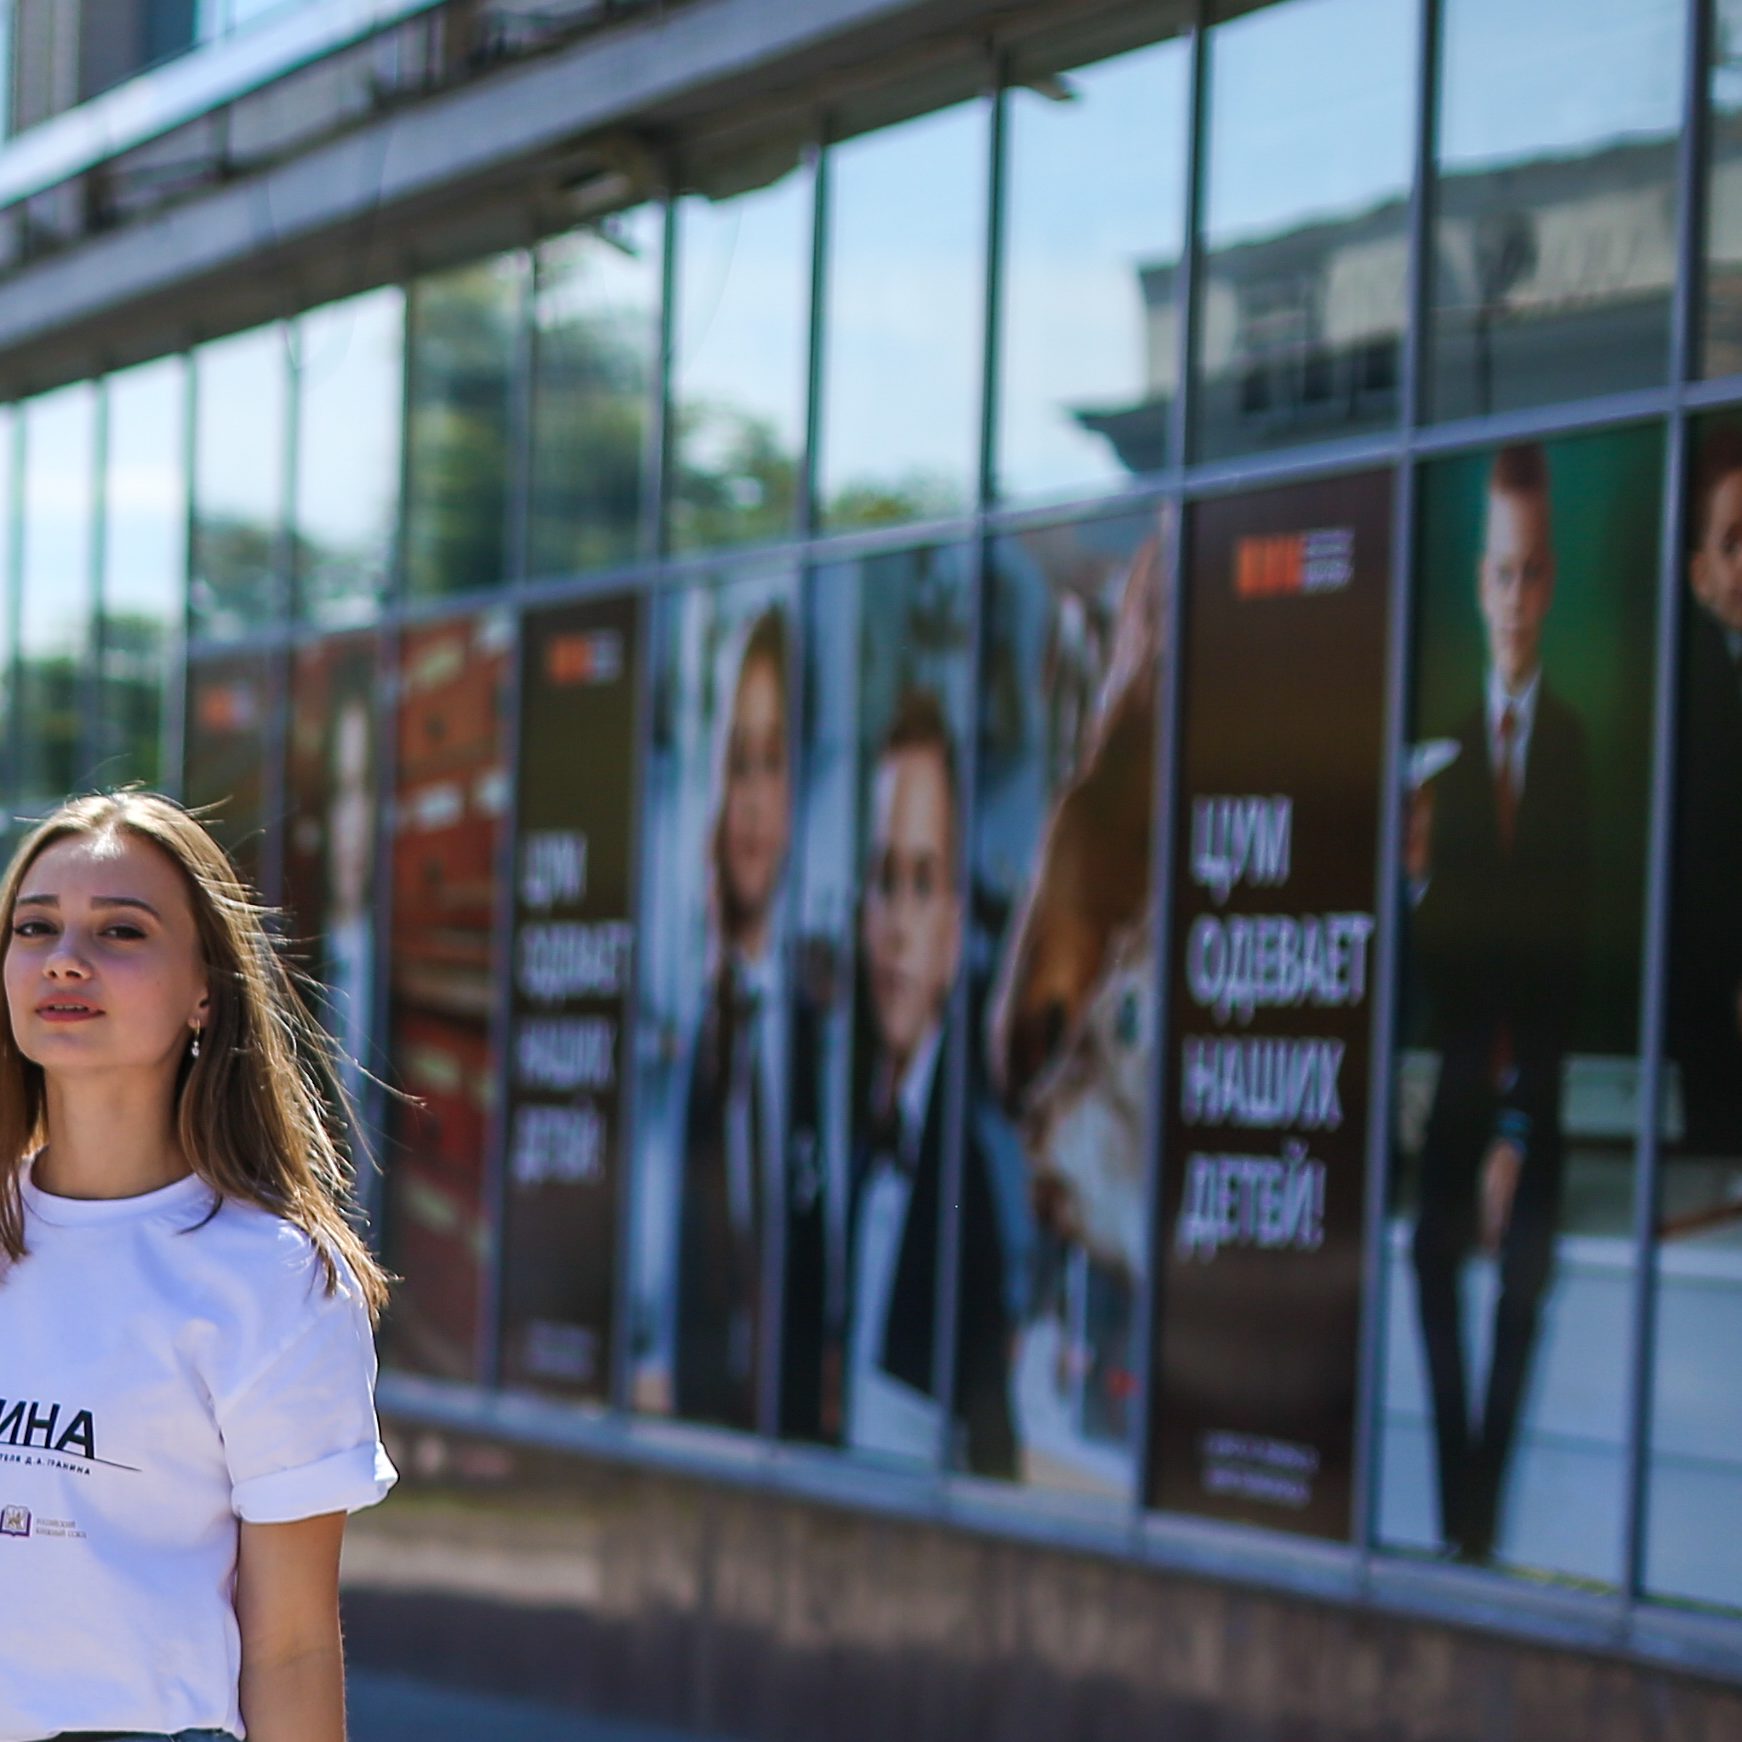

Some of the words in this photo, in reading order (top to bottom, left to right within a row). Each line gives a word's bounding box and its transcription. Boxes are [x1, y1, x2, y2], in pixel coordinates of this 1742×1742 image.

[1192, 797, 1291, 903] ЦУМ
[1187, 914, 1373, 1024] ОДЕВАЕТ
[1182, 1037, 1345, 1130] НАШИХ
[1176, 1138, 1325, 1262] ДЕТЕЙ!
